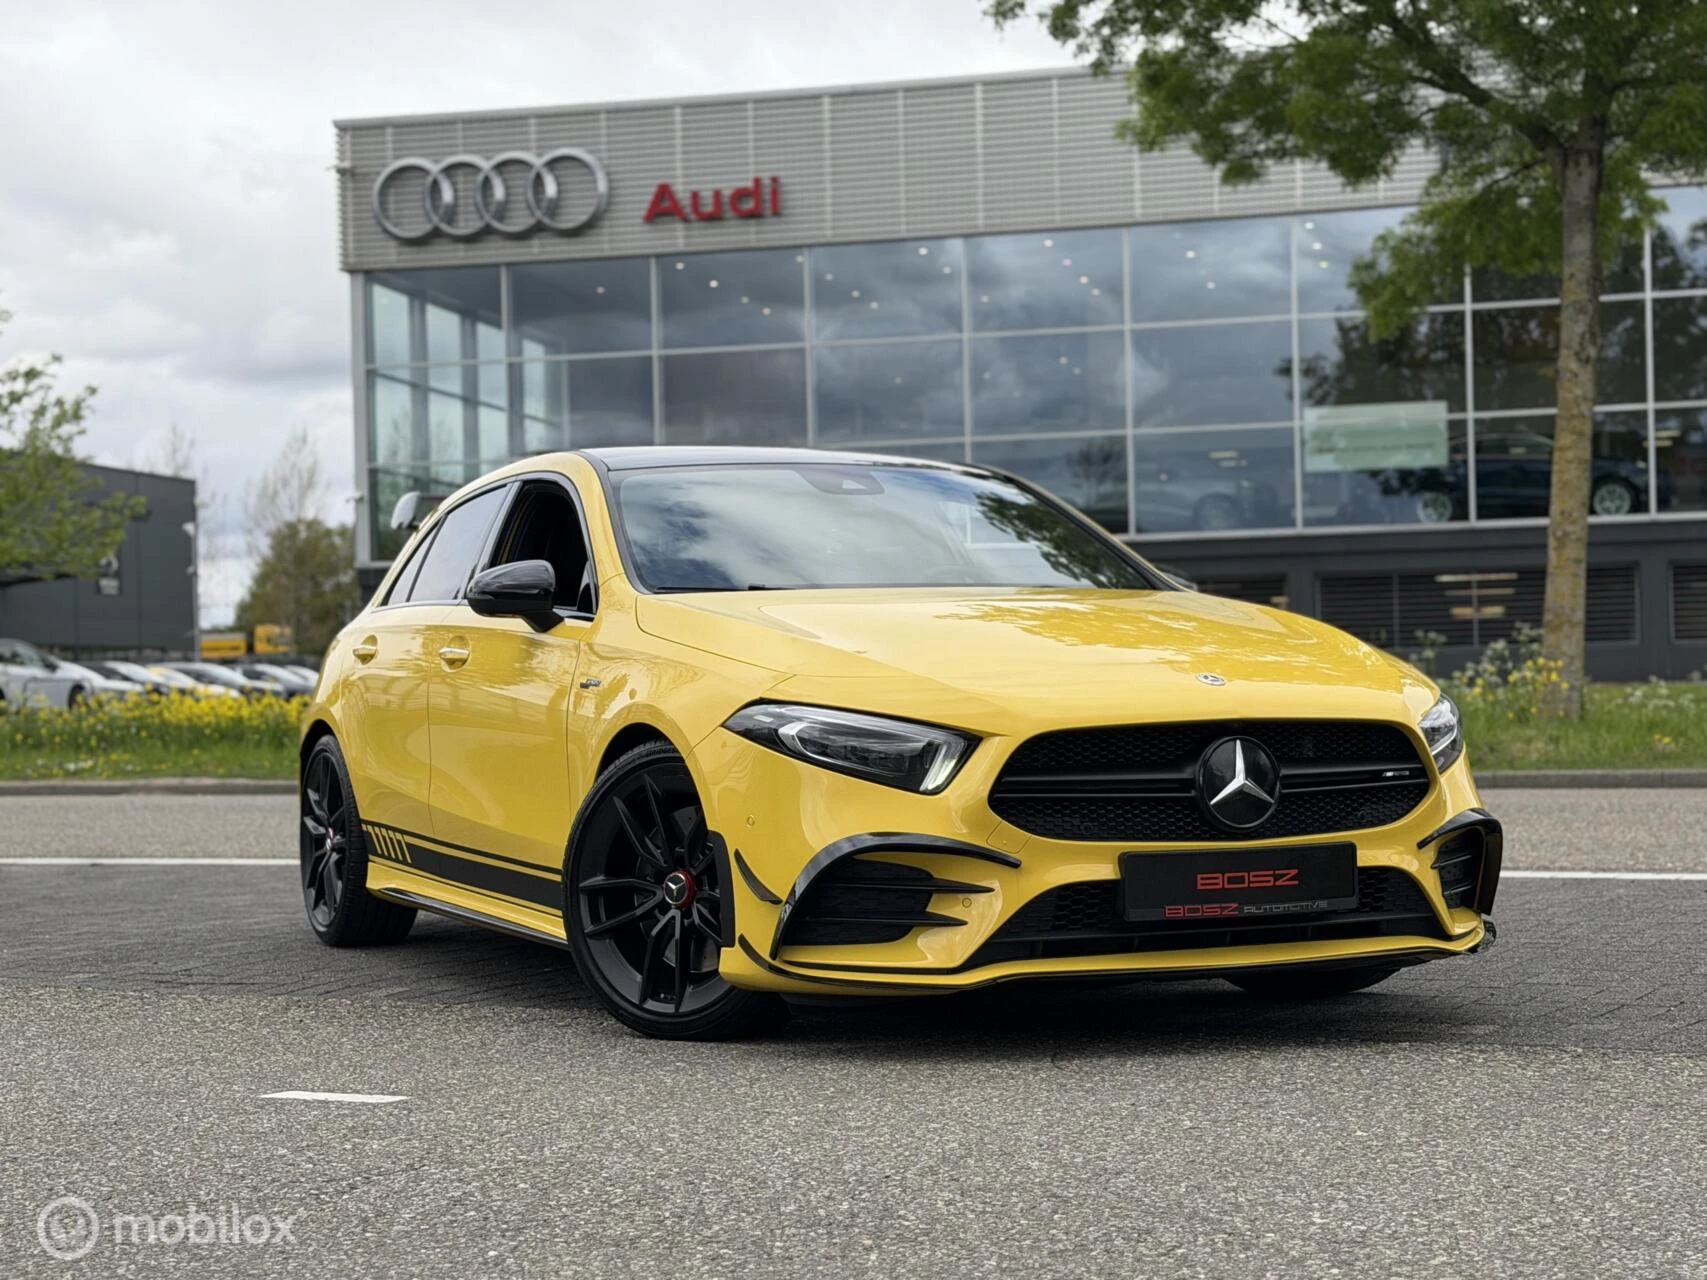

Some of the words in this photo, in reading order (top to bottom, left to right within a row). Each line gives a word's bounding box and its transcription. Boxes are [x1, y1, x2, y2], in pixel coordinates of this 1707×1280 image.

[643, 175, 781, 223] Audi
[1197, 869, 1299, 890] BOSZ
[1165, 903, 1239, 918] BOSZ
[1244, 900, 1329, 913] AUTOMOTIVE
